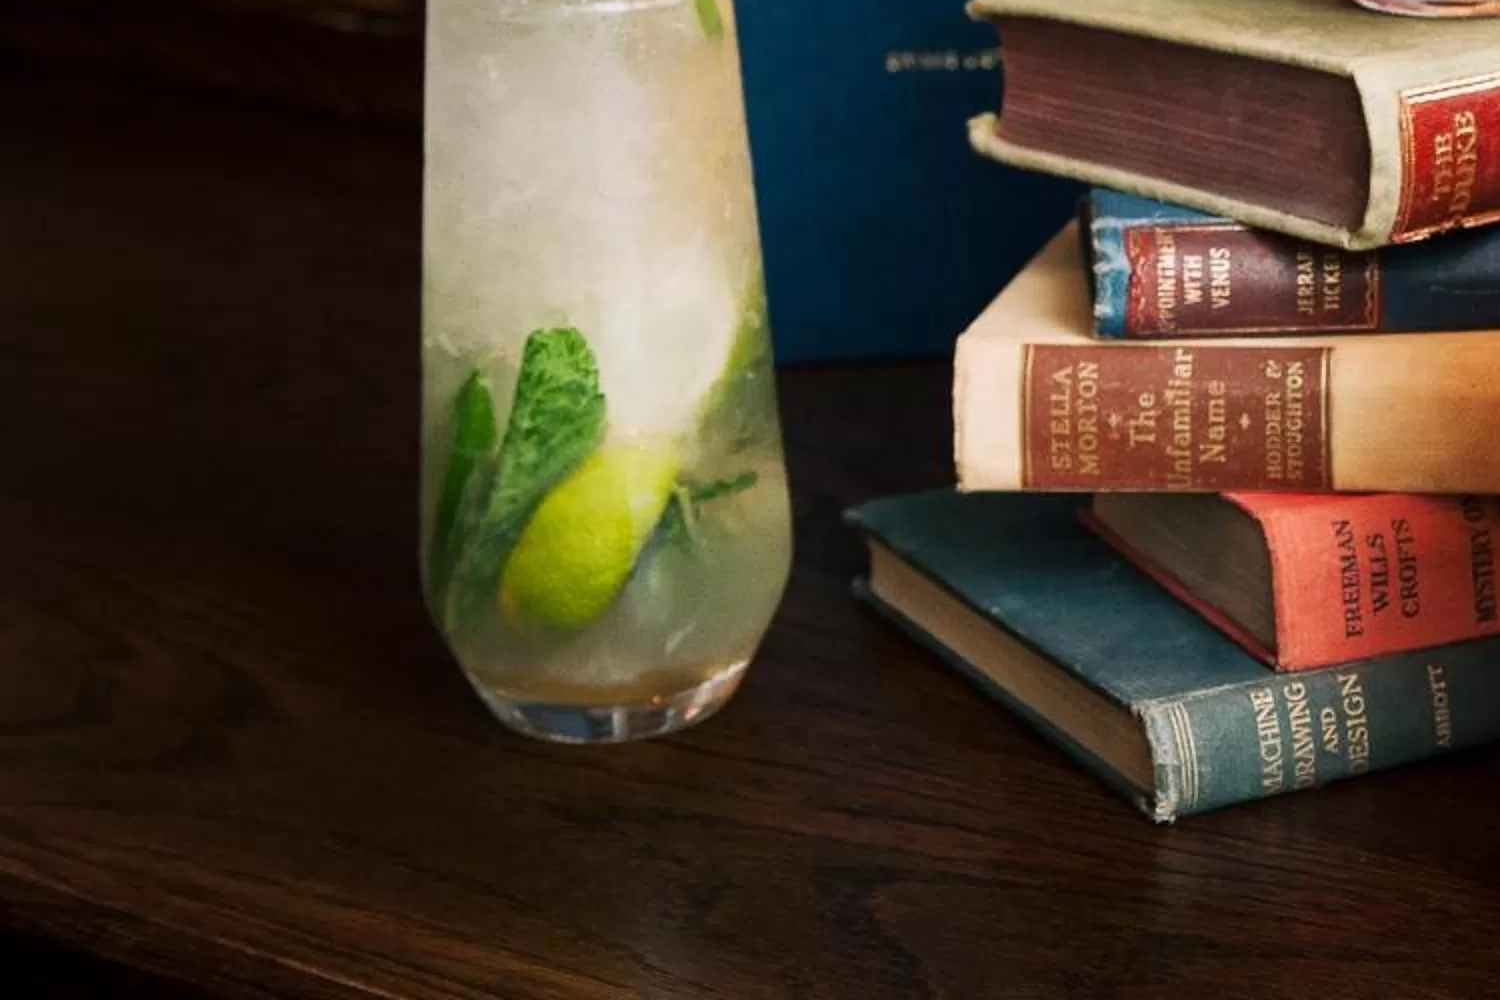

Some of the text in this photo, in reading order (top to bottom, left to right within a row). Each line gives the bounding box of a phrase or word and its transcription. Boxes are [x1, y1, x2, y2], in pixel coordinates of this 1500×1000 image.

[1433, 133, 1453, 201] THE
[1450, 111, 1477, 213] DUKE
[1182, 254, 1203, 305] WITH
[1209, 246, 1231, 309] VENUS
[1050, 366, 1073, 469] STELLA
[1077, 359, 1101, 476] MORTON
[1128, 391, 1158, 447] The
[1165, 347, 1194, 489] Unfamiliar
[1200, 379, 1228, 463] Name
[1262, 358, 1284, 481] HODDER &
[1285, 360, 1305, 481] STOUGHTON
[1335, 520, 1363, 638] FREEMAN
[1366, 533, 1390, 616] WILLS
[1393, 518, 1419, 618] CROFTS
[1473, 530, 1496, 623] MYSTERY
[1250, 688, 1283, 793] MACHINE
[1283, 681, 1317, 788] DRAWING
[1321, 705, 1341, 754] AND
[1338, 673, 1369, 775] DESIGN
[1428, 665, 1452, 746] ABBOTT
